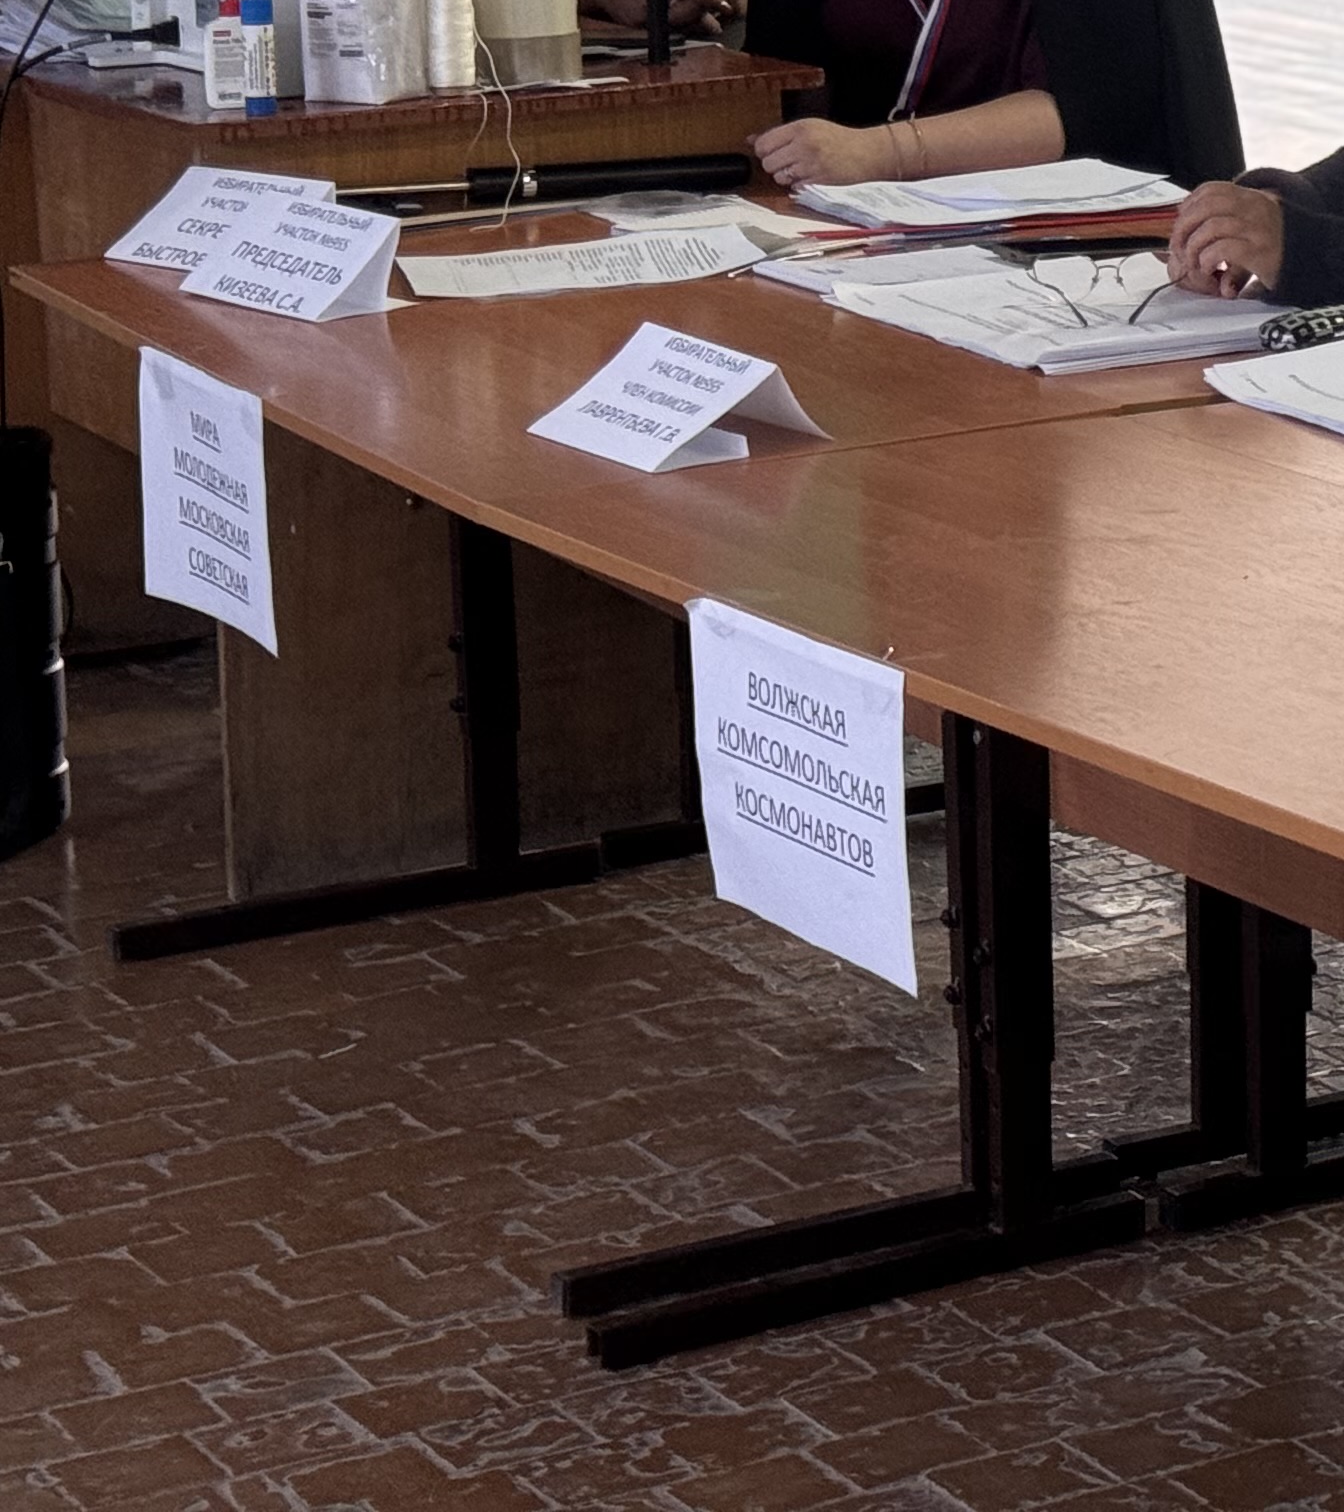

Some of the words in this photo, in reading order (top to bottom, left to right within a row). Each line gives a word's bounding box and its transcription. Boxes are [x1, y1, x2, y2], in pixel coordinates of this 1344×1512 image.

[275, 222, 319, 241] УЧАСТОК
[232, 241, 343, 286] ПРЕДСЕДАТЕЛЬ
[214, 275, 278, 306] КИЗЕЕВА
[649, 359, 692, 384] УЧАСТОК
[665, 336, 751, 375] ИЗБИРАТЕЛЬНЫЙ
[578, 400, 659, 436] ЛАВРЕНТЬЕВА
[623, 381, 647, 397] ЧЛЕН
[646, 387, 703, 416] КОМИССИИ
[191, 411, 220, 447] МИРА
[174, 447, 249, 506] МОЛОДЕЖНАЯ
[179, 496, 250, 553] МОСКОВСКАЯ
[189, 547, 249, 598] СОВЕТСКАЯ
[748, 672, 846, 738] ВОЛЖСКАЯ
[717, 717, 885, 816] КОМСОМОЛЬСКАЯ
[735, 781, 874, 868] КОСМОНАВТОВ
